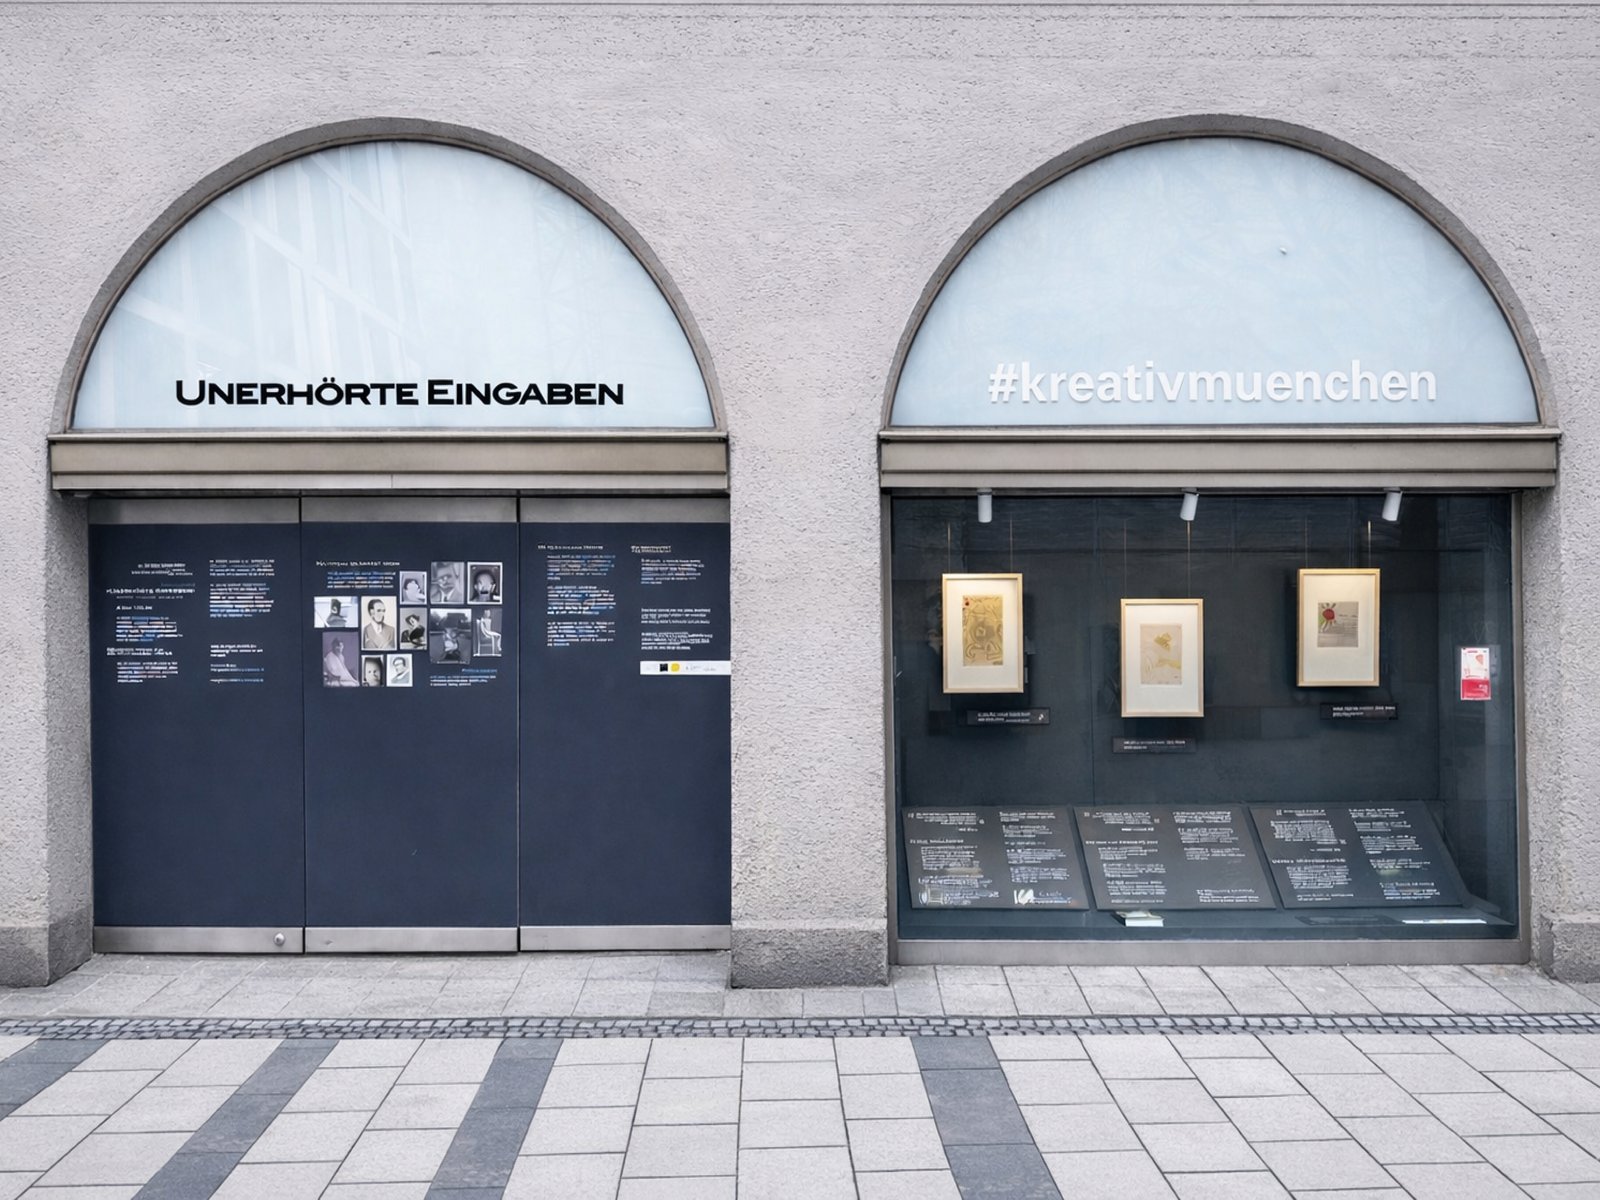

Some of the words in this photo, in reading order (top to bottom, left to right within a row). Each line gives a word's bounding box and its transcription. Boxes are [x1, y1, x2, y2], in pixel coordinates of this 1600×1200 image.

[176, 377, 419, 405] UNERHÖRTE
[428, 380, 623, 405] EINGABEN
[988, 359, 1437, 402] #kreativmuenchen
